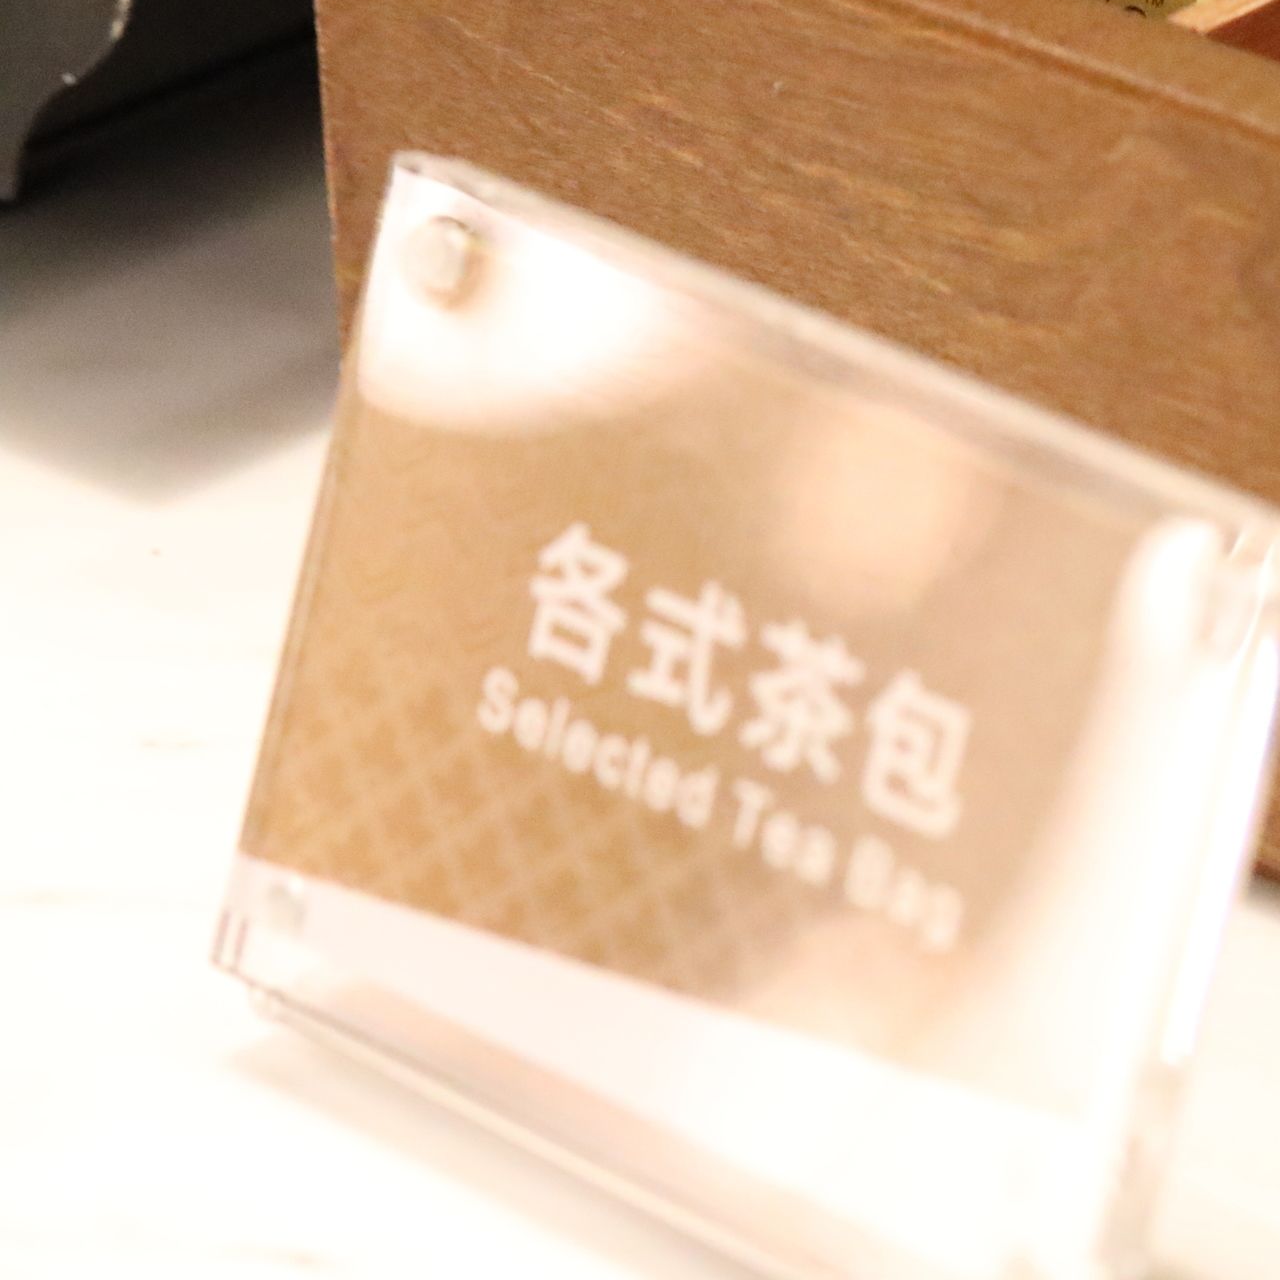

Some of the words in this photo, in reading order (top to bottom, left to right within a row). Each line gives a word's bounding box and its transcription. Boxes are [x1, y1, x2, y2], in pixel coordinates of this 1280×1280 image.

[476, 664, 718, 831] Selected
[731, 776, 837, 887] Tea
[844, 833, 964, 955] Bag
[526, 520, 971, 841] 各式茶包
